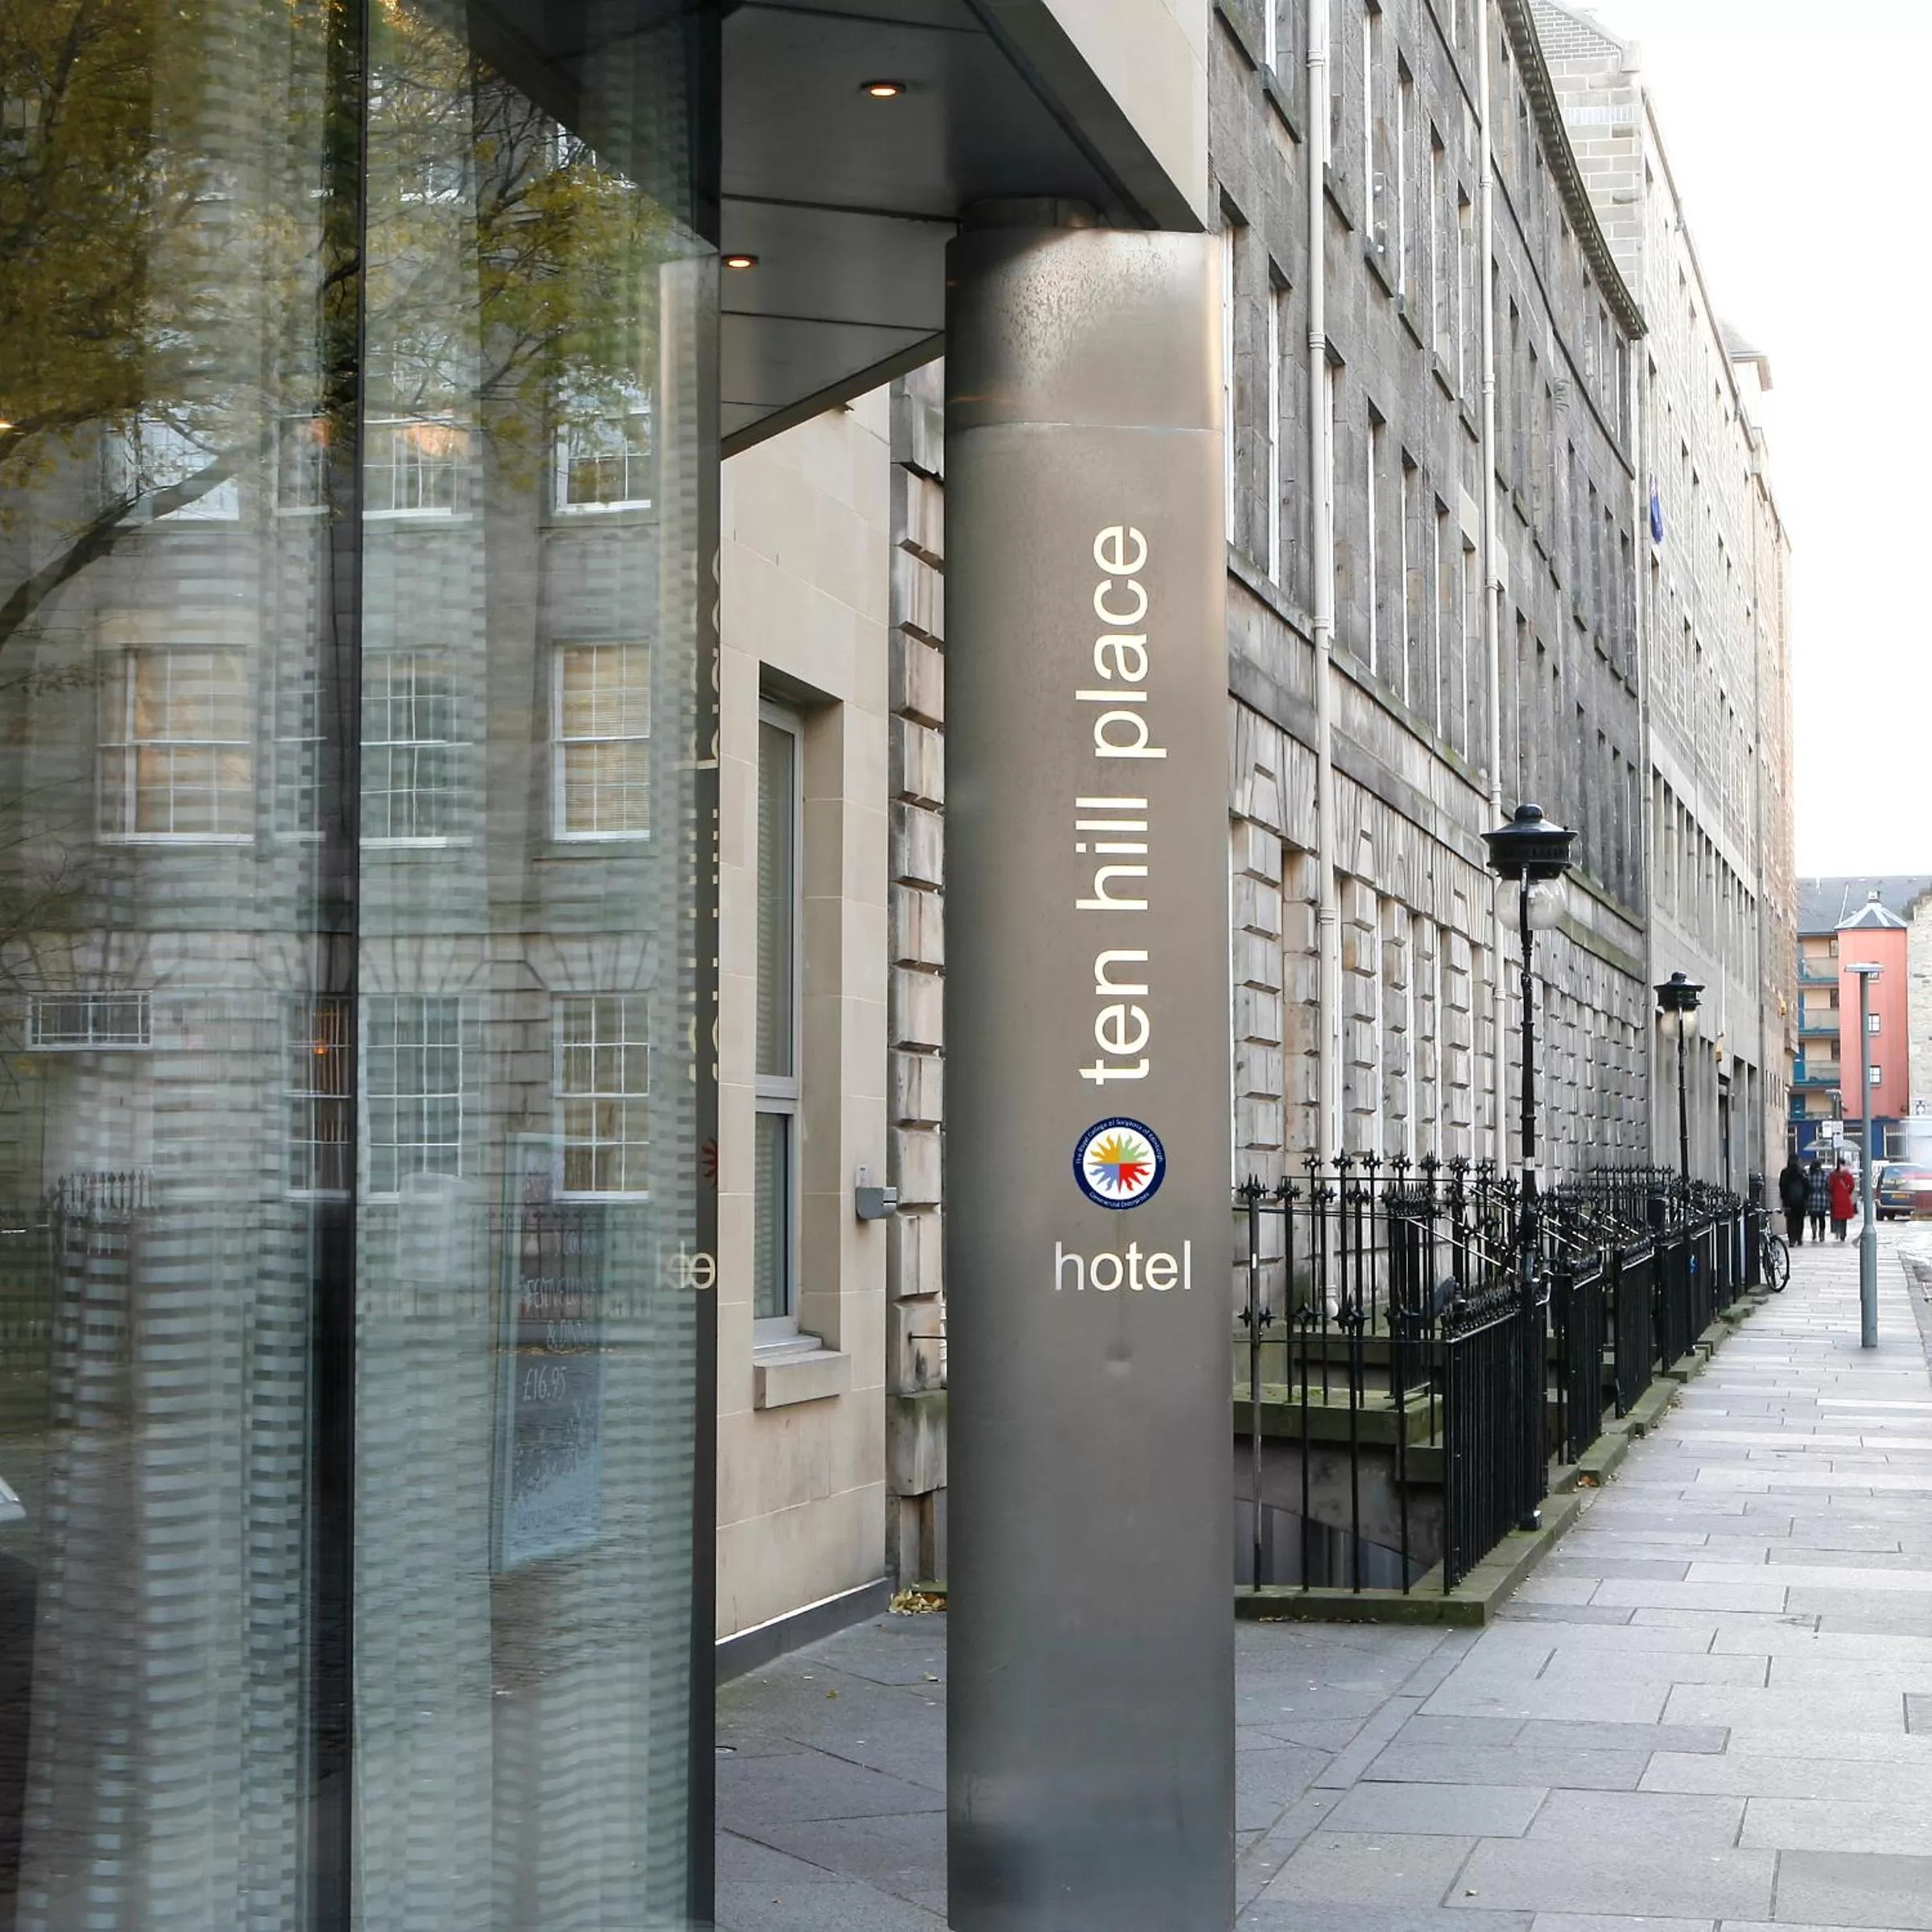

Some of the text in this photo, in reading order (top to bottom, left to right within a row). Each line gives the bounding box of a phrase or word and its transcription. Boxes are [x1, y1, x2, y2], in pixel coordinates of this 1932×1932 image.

[1075, 526, 1167, 1085] ten hill place
[1055, 1240, 1191, 1291] hotel
[522, 1365, 568, 1402] £16.95
